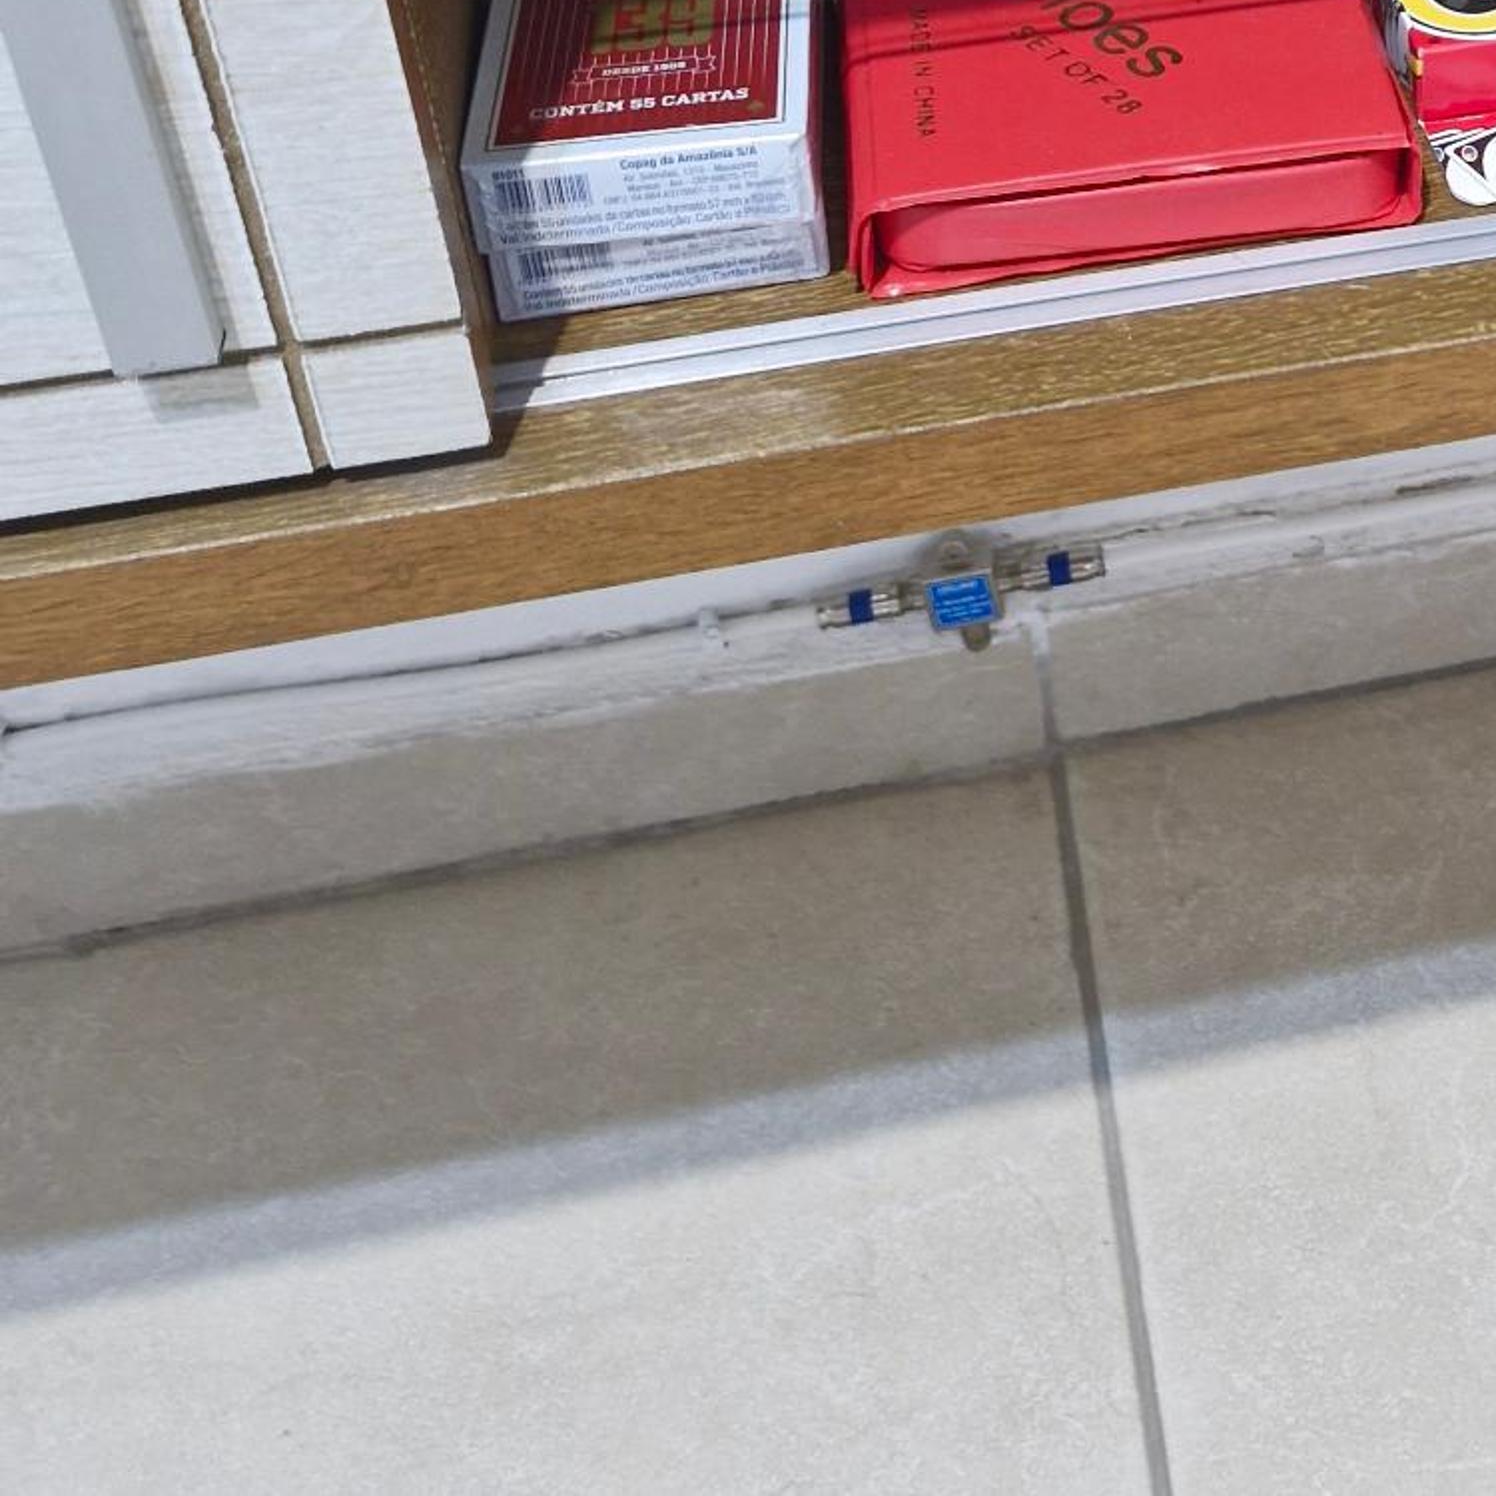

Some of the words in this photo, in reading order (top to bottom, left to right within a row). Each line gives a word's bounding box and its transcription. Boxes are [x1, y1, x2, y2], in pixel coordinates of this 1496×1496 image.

[908, 6, 932, 53] MADE
[914, 60, 932, 77] IN
[1009, 24, 1070, 62] SET
[1064, 60, 1109, 86] OF
[1101, 88, 1143, 115] 28
[529, 98, 625, 121] CONTÉM
[630, 96, 657, 111] 55
[662, 87, 750, 109] CARTAS
[914, 85, 936, 138] CHINA
